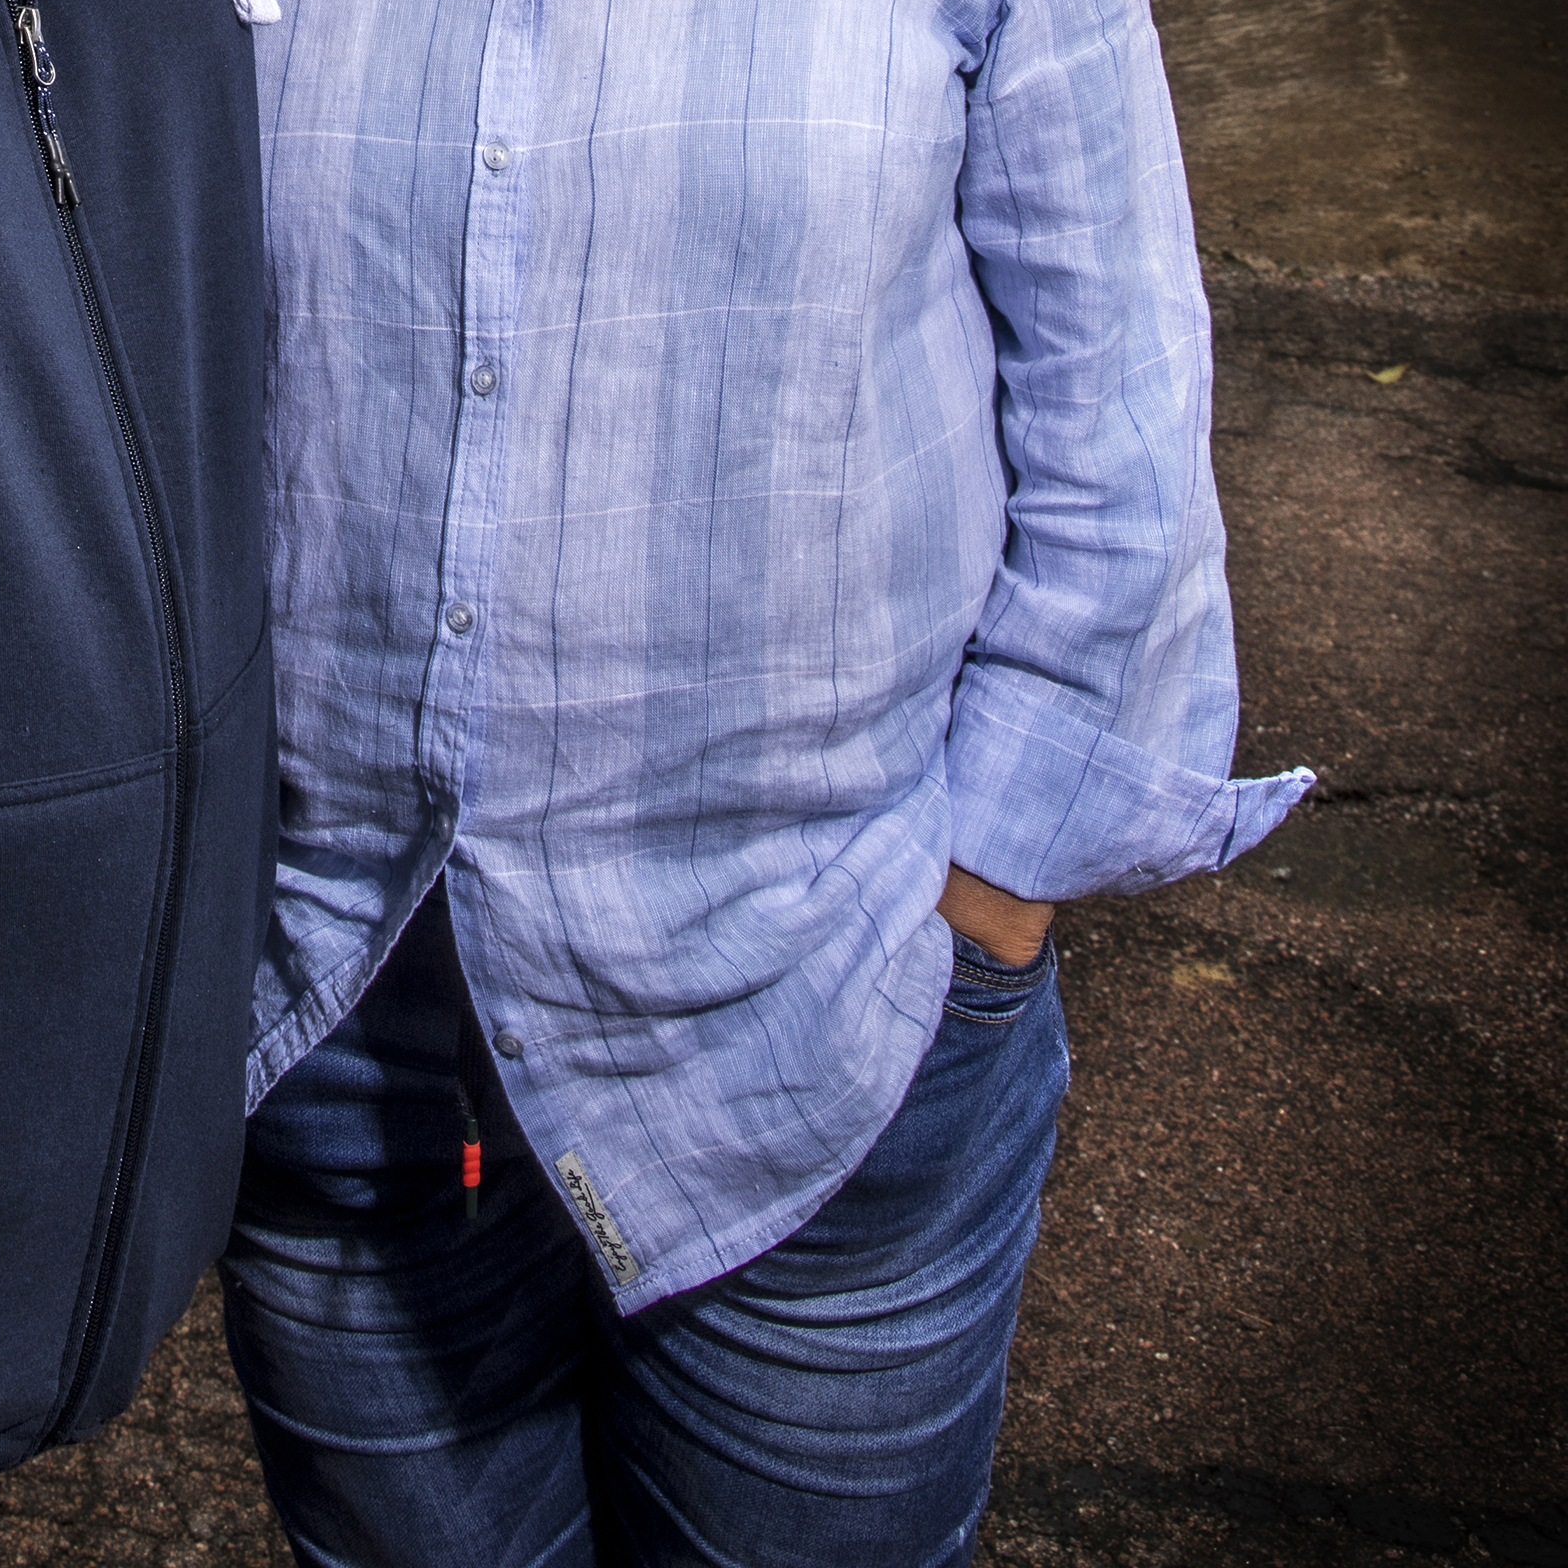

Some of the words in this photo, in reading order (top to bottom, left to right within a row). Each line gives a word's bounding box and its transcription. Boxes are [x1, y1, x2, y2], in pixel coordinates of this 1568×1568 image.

[567, 1168, 582, 1191] Life
[576, 1182, 605, 1222] Good
[594, 1221, 610, 1247] The
[607, 1240, 628, 1272] Enjoy
